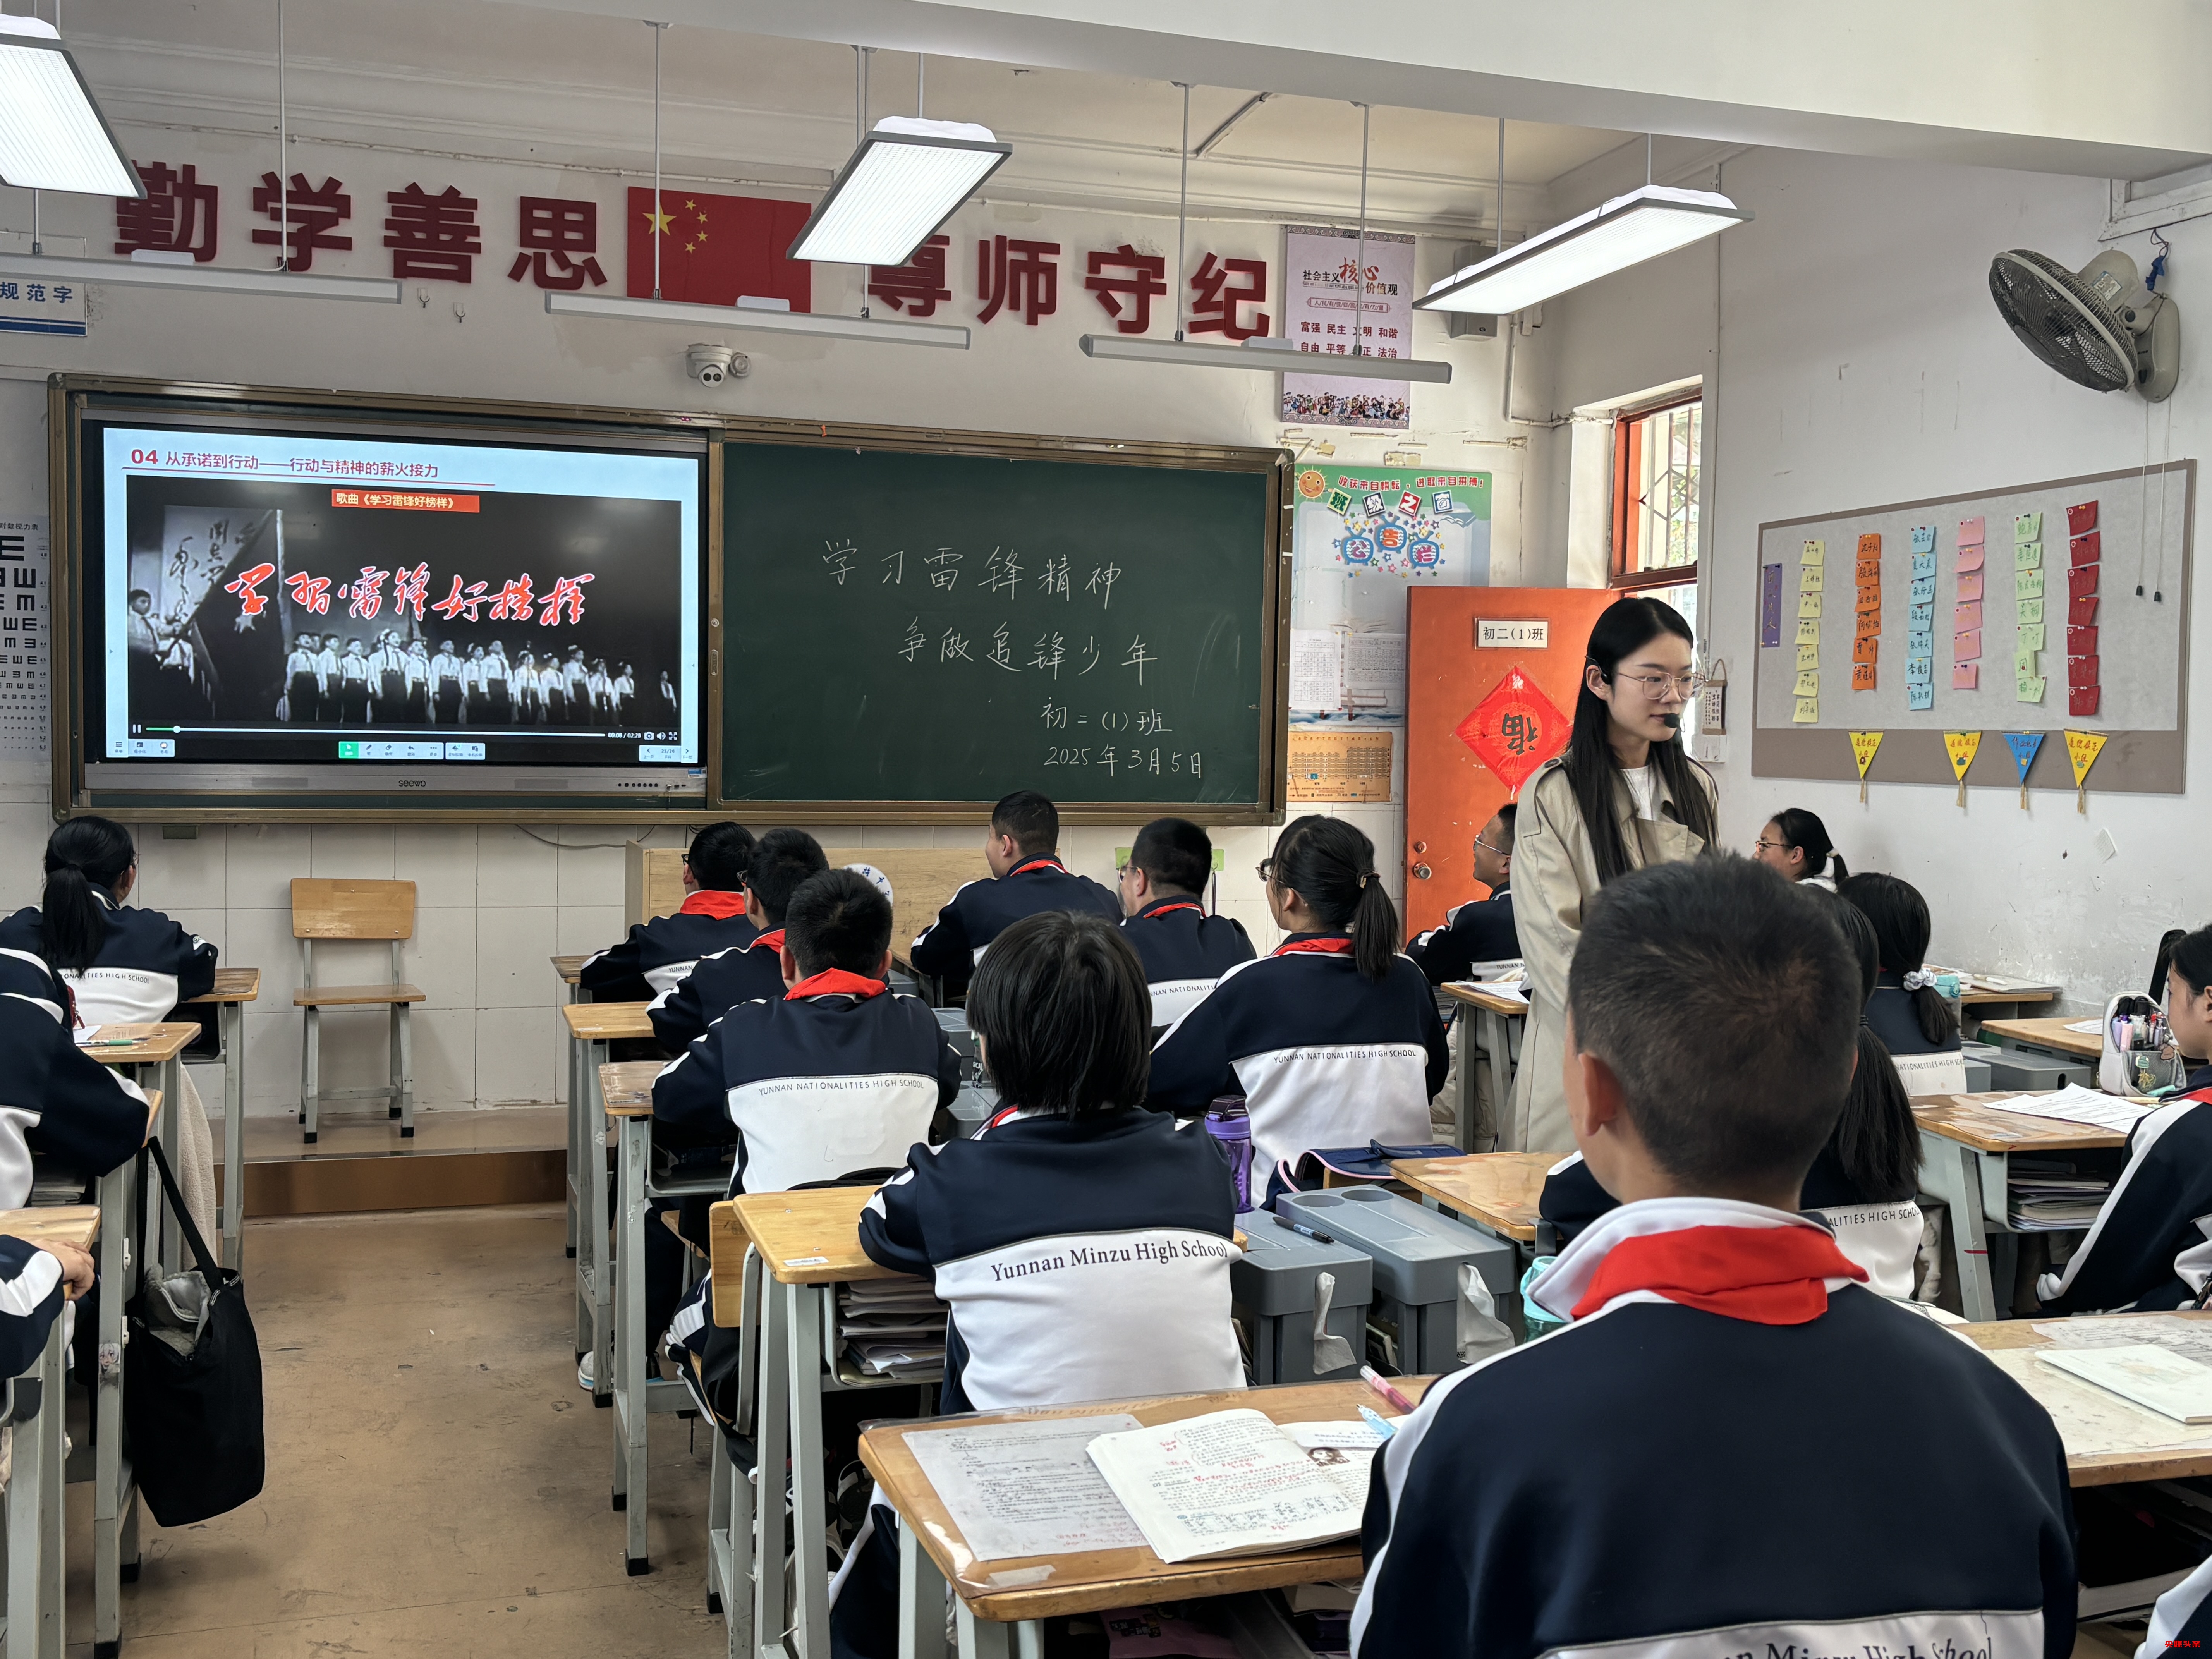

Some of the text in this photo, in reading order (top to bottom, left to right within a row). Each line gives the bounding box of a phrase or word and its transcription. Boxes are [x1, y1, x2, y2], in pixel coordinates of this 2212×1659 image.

[114, 160, 1270, 340] 勤学善思 尊师守纪
[1303, 257, 1379, 284] 社会主义 核心
[0, 282, 73, 303] 规范字
[1366, 282, 1398, 296] 价值观
[1301, 321, 1321, 333] 富强
[1327, 324, 1346, 335] 民主
[1379, 328, 1398, 339] 和谐
[1301, 342, 1319, 352] 自由
[1326, 343, 1346, 355] 平等
[1378, 347, 1397, 359] 法治
[131, 449, 438, 478] 04 从承诺到行动——行动与精神的薪火接力
[336, 493, 454, 509] 歌曲《学习雷锋好榜样》
[823, 539, 1121, 609] 学习雷锋精神
[1483, 627, 1544, 641] 初二(1)班
[898, 616, 1158, 685] 争做追锋少年
[1501, 713, 1538, 756] 福
[1044, 744, 1201, 779] 2025年3月5日
[1274, 1053, 1304, 1064] YUNNAN
[1307, 1051, 1366, 1060] NATIONALITIES
[759, 1079, 924, 1096] YUNNAN NATIONALITIES HIGH SCHOOL
[1869, 1210, 1896, 1222] HIGH
[991, 1240, 1227, 1281] Yunnan Minzu High School
